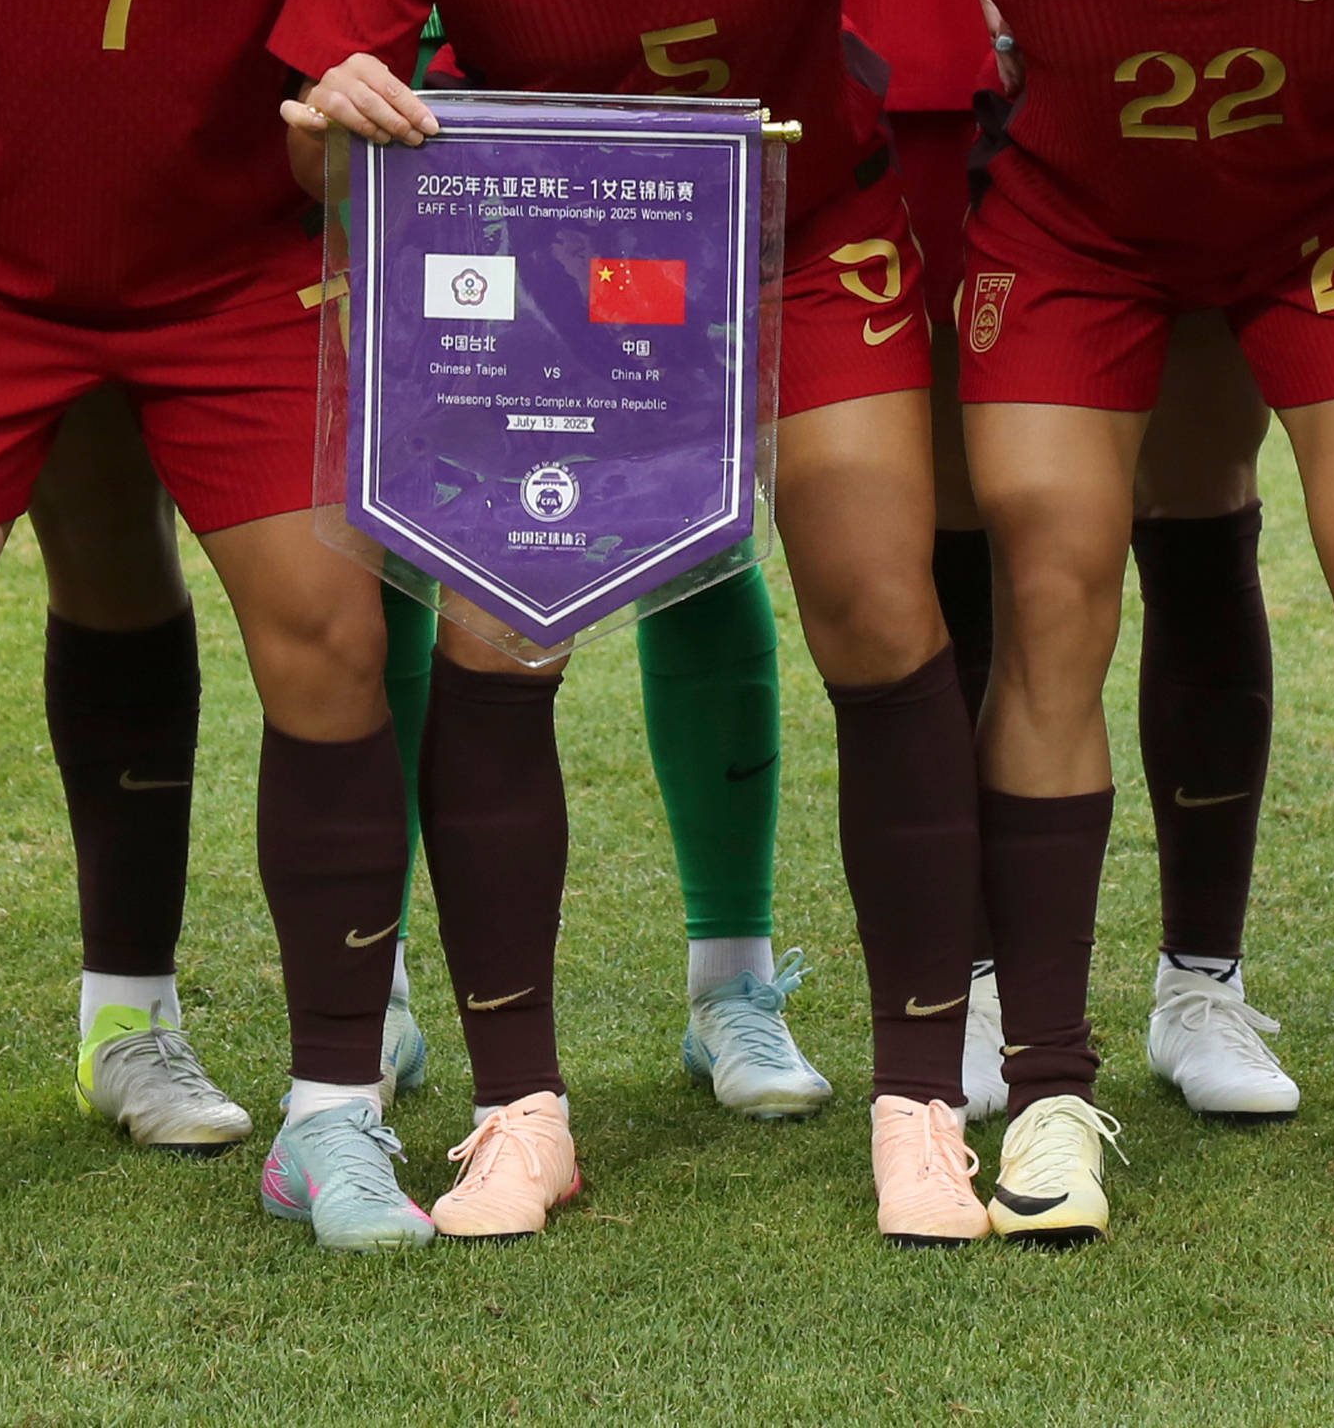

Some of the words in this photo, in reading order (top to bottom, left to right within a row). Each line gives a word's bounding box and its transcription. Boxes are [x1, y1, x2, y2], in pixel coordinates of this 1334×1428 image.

[640, 18, 730, 96] 5
[1114, 46, 1286, 141] 22
[417, 202, 445, 215] EAFF
[478, 204, 524, 218] Football
[528, 205, 606, 222] Championship
[610, 207, 637, 220] 2025
[979, 278, 1010, 293] CFA
[440, 334, 496, 352] 中国台北
[622, 340, 651, 357] 中国
[429, 361, 471, 376] Chinese
[476, 363, 507, 378] Taipei
[543, 366, 562, 380] VS
[611, 369, 642, 382] China
[645, 370, 660, 383] PR
[436, 393, 492, 409] Hwaseong
[495, 394, 532, 408] Sports
[587, 396, 617, 409] Korea
[621, 396, 668, 411] Republic
[513, 416, 537, 431] July
[563, 418, 589, 430] 2025
[541, 498, 558, 507] CFA
